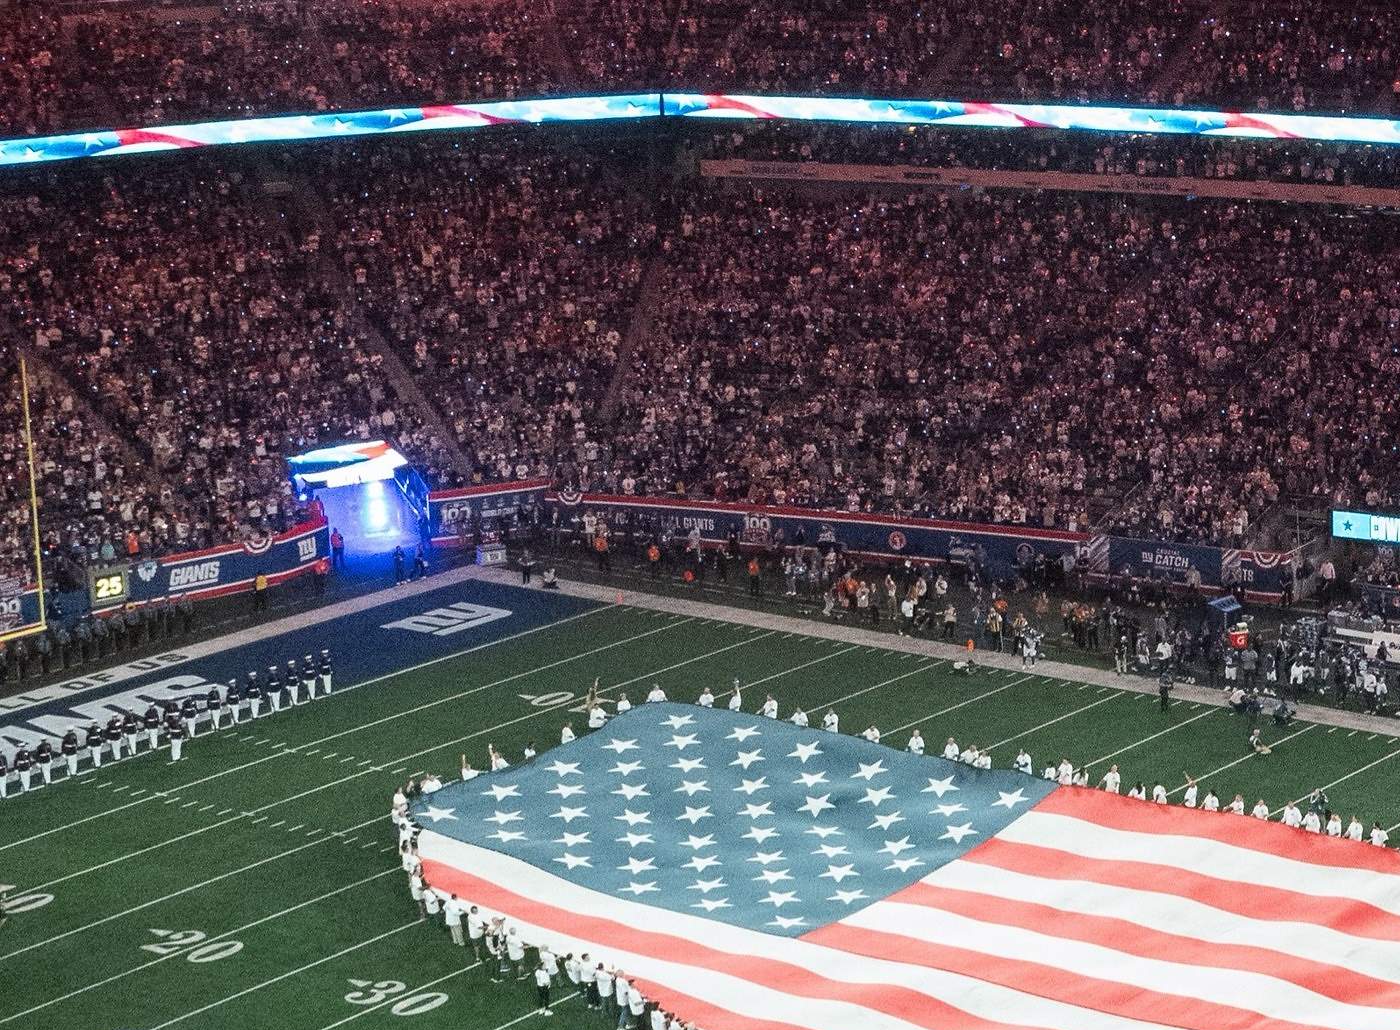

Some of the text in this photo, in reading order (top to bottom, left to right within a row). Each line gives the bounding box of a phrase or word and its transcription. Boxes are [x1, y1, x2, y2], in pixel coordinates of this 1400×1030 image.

[743, 517, 772, 535] 100
[1154, 553, 1190, 569] CATCH
[95, 577, 123, 599] 25
[168, 561, 220, 590] GIANTS
[139, 929, 244, 963] 20
[344, 979, 449, 1015] 30
